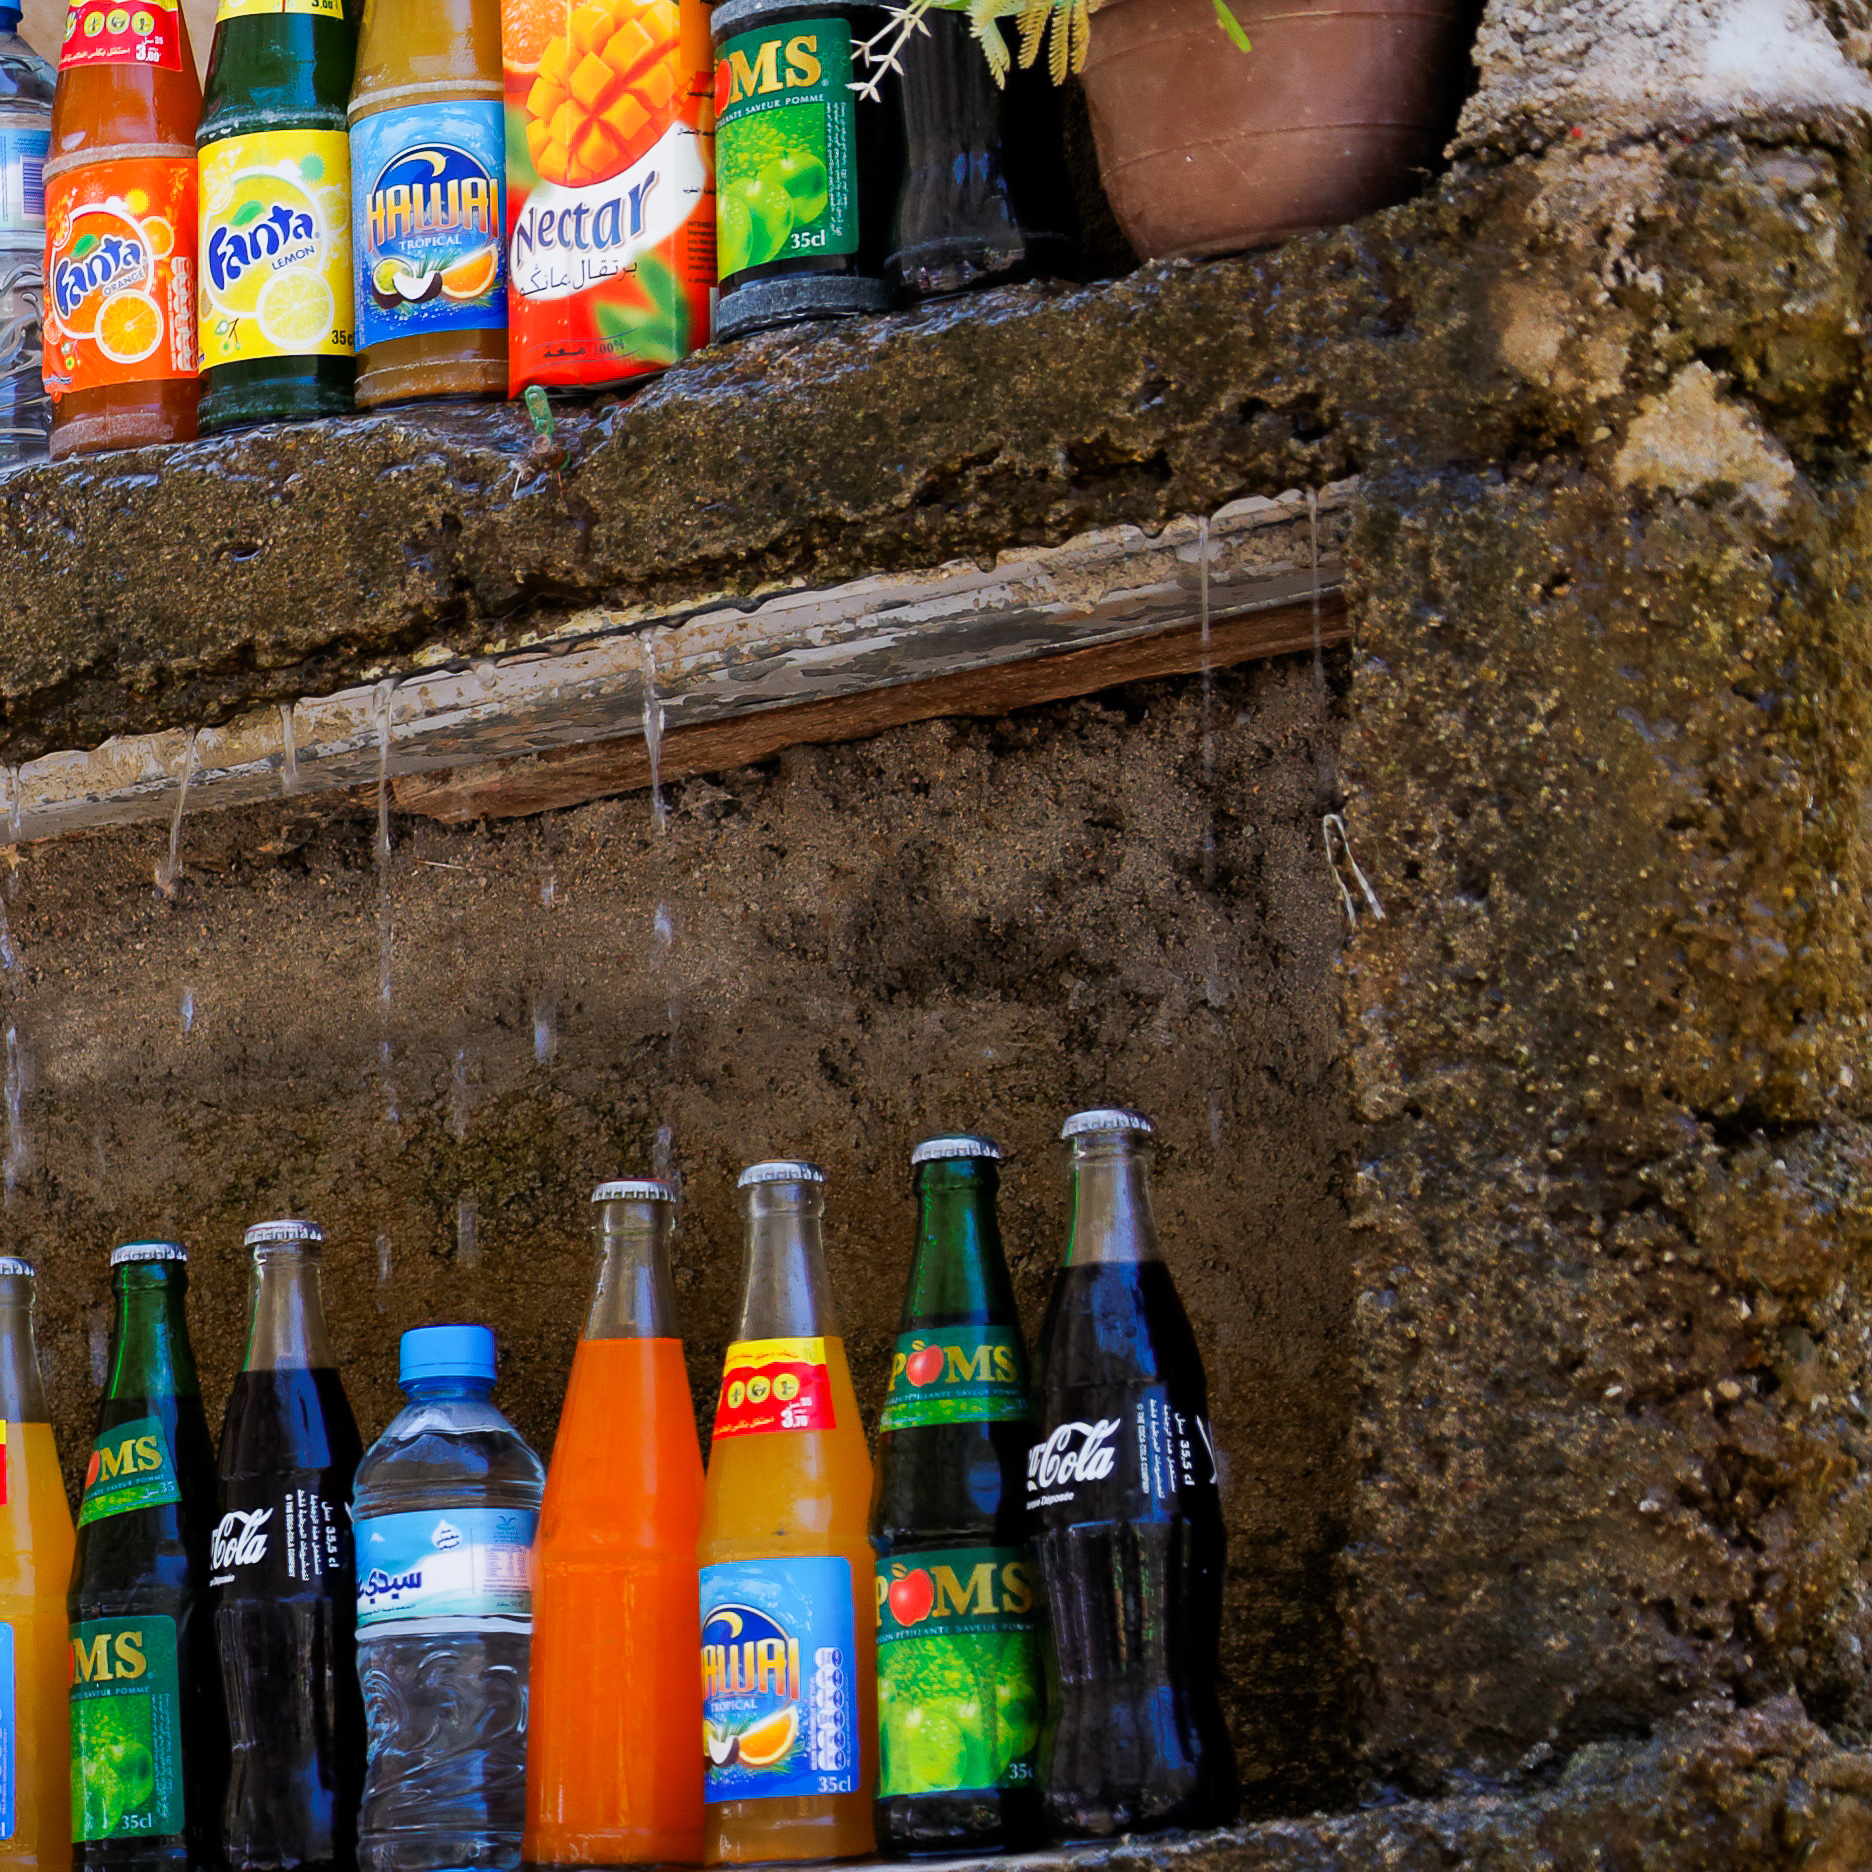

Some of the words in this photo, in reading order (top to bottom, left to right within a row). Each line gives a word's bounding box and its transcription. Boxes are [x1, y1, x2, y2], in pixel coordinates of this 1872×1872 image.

[744, 99, 781, 114] SAVEUR
[784, 93, 825, 105] POMME
[365, 176, 499, 254] HAWAI
[516, 170, 656, 268] Nectar
[208, 205, 314, 292] Fanta
[399, 234, 463, 252] TROPICAL
[790, 228, 827, 249] 35cl
[271, 245, 316, 271] LEMON
[56, 239, 144, 319] Fanta
[103, 268, 145, 298] ORANGE
[331, 329, 354, 345] 35c
[364, 1569, 422, 1604] سيدي
[955, 1622, 999, 1633] SAVEUR
[702, 1636, 801, 1702] AWAI
[710, 1700, 759, 1714] TROPICAL
[1008, 1763, 1034, 1781] 35c
[818, 1775, 853, 1794] 35cl
[121, 1813, 154, 1831] 35cl
